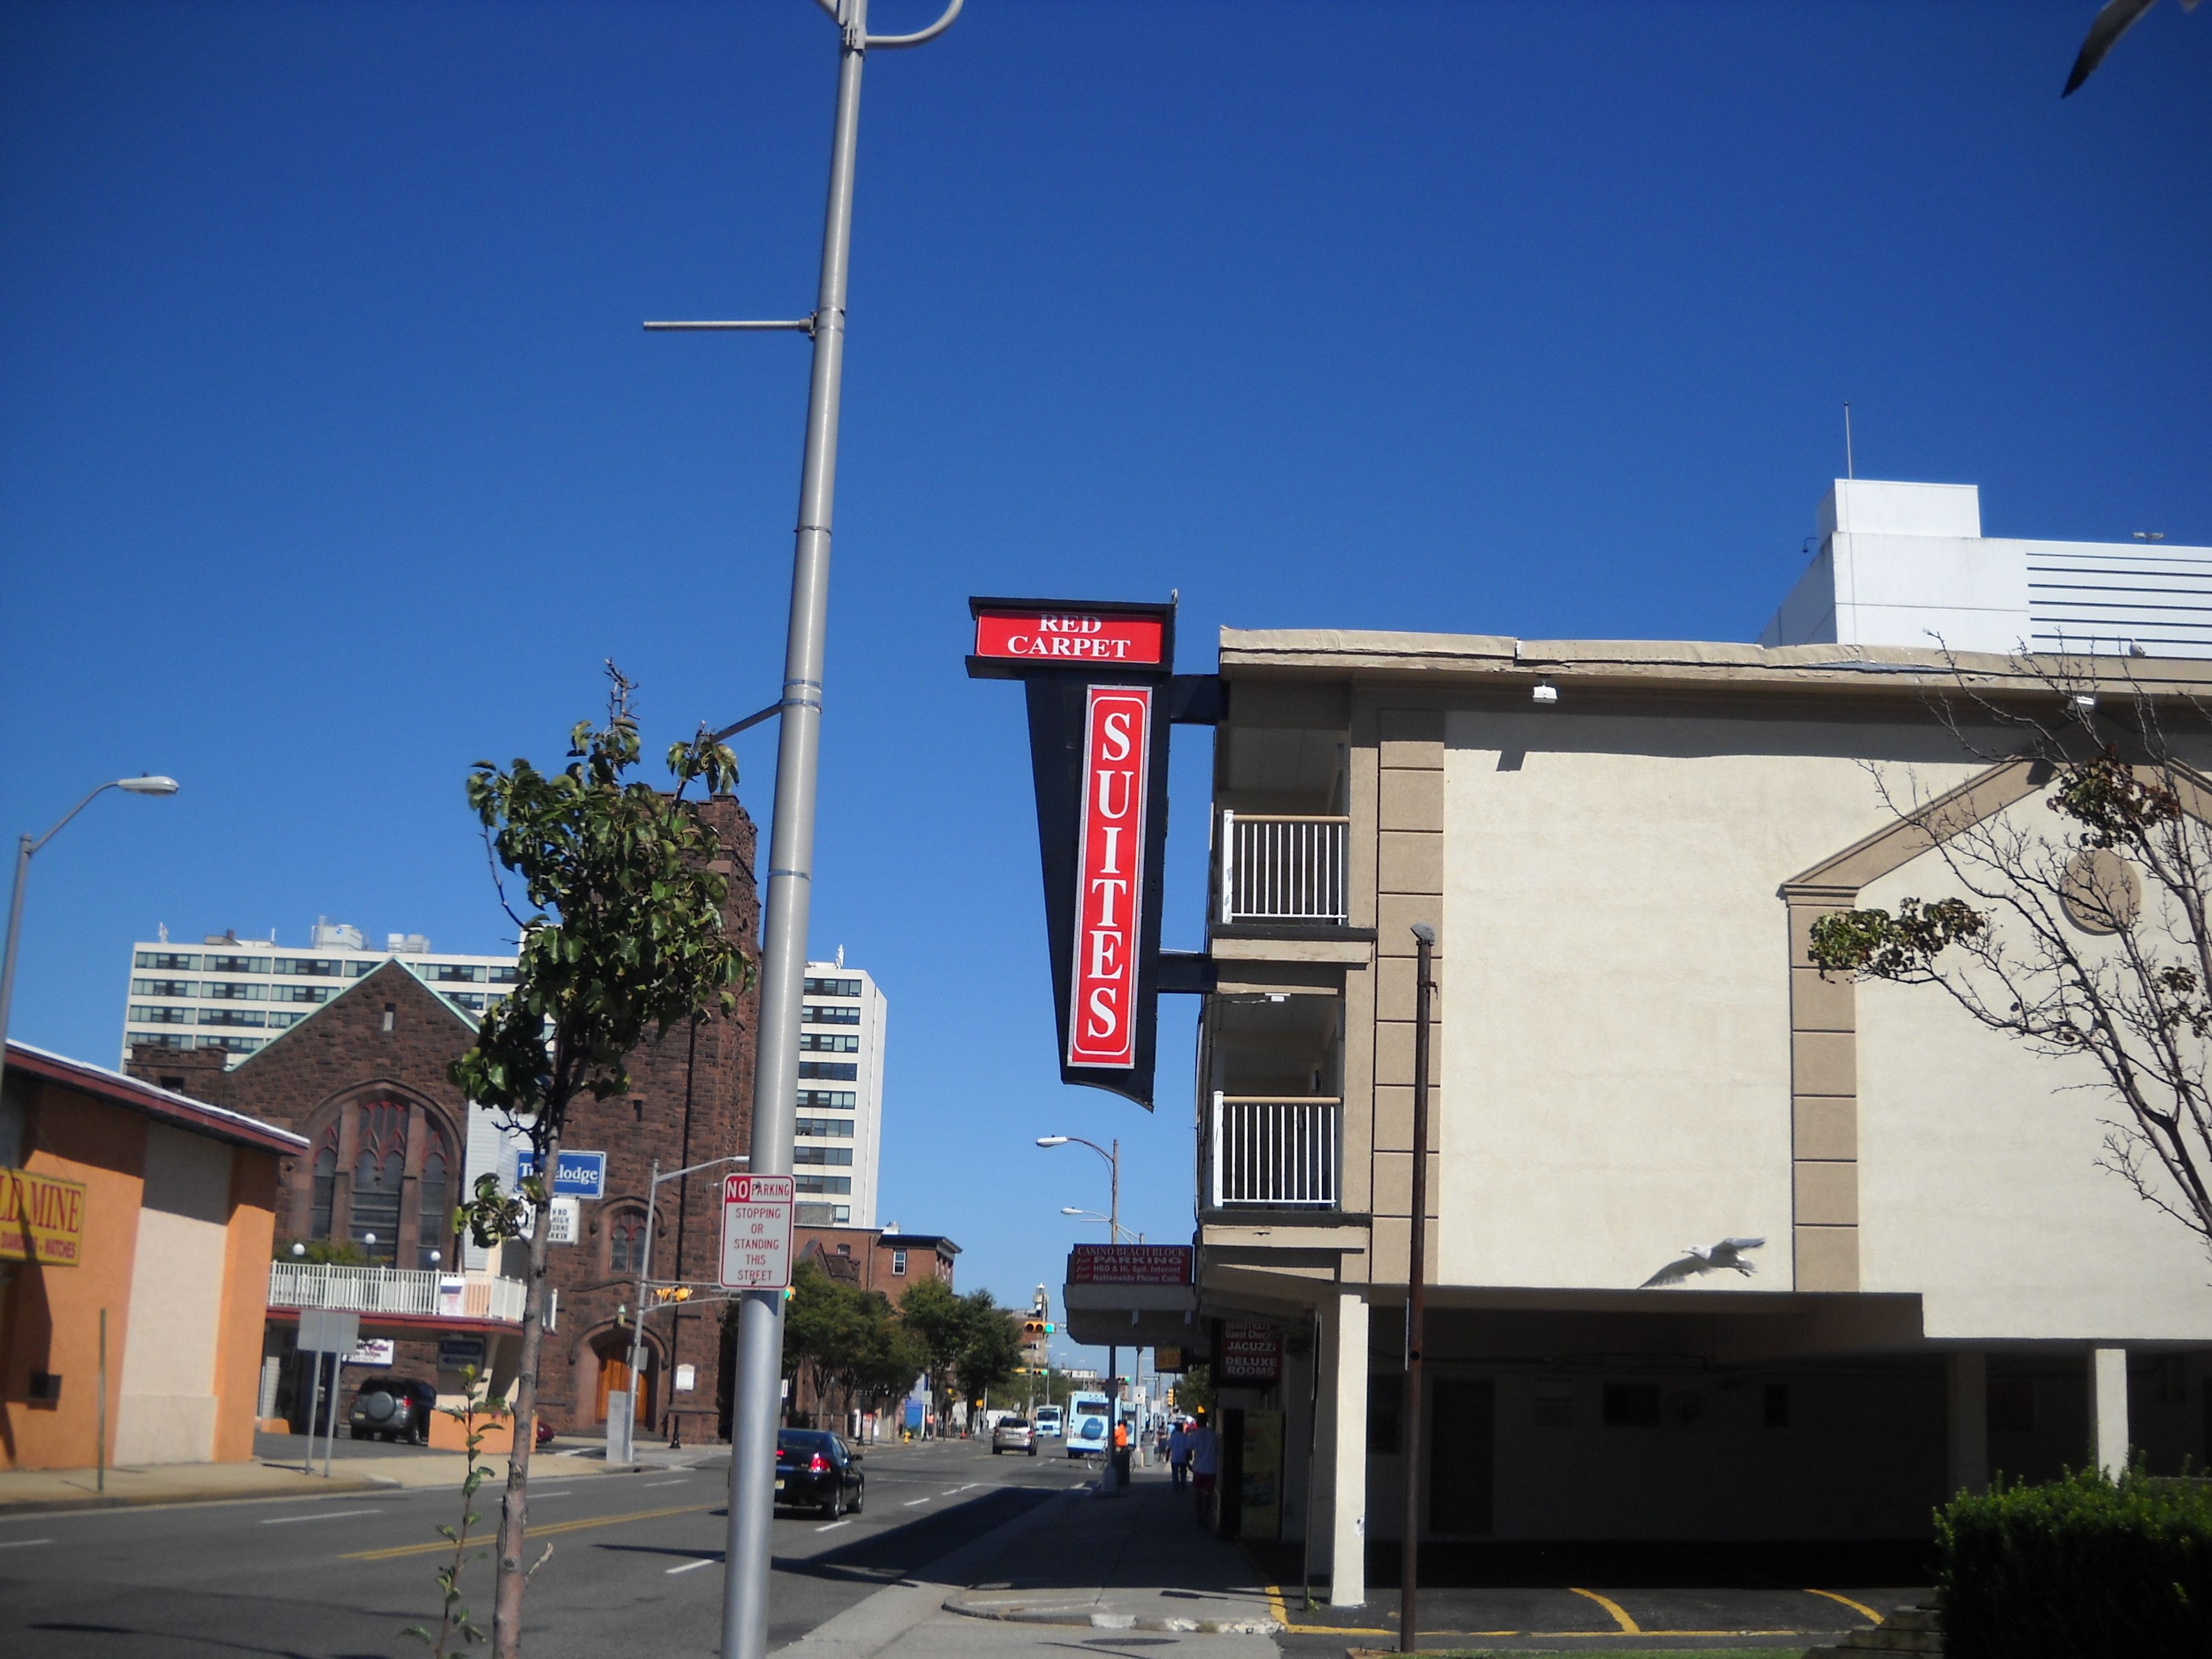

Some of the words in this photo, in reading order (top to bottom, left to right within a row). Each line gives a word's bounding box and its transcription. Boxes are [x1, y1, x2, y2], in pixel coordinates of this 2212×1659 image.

[1038, 614, 1102, 634] RED
[1007, 635, 1131, 658] CARPET
[1087, 712, 1134, 1038] SUITES
[727, 1180, 749, 1199] NO
[751, 1184, 789, 1196] PARKING
[25, 1181, 81, 1233] MINE
[736, 1207, 781, 1219] STOPPING
[751, 1223, 763, 1234] OR
[734, 1238, 779, 1250] STANDING
[1078, 1247, 1114, 1256] CASINO
[1117, 1247, 1150, 1257] BEACH
[1153, 1247, 1185, 1257] BLOCK
[746, 1254, 766, 1265] THIS
[737, 1269, 773, 1281] STREET
[1225, 1330, 1247, 1339] Guest
[1227, 1341, 1276, 1352] JACUZZI
[1225, 1356, 1278, 1367] DELUXE
[1227, 1366, 1275, 1376] ROOMS
